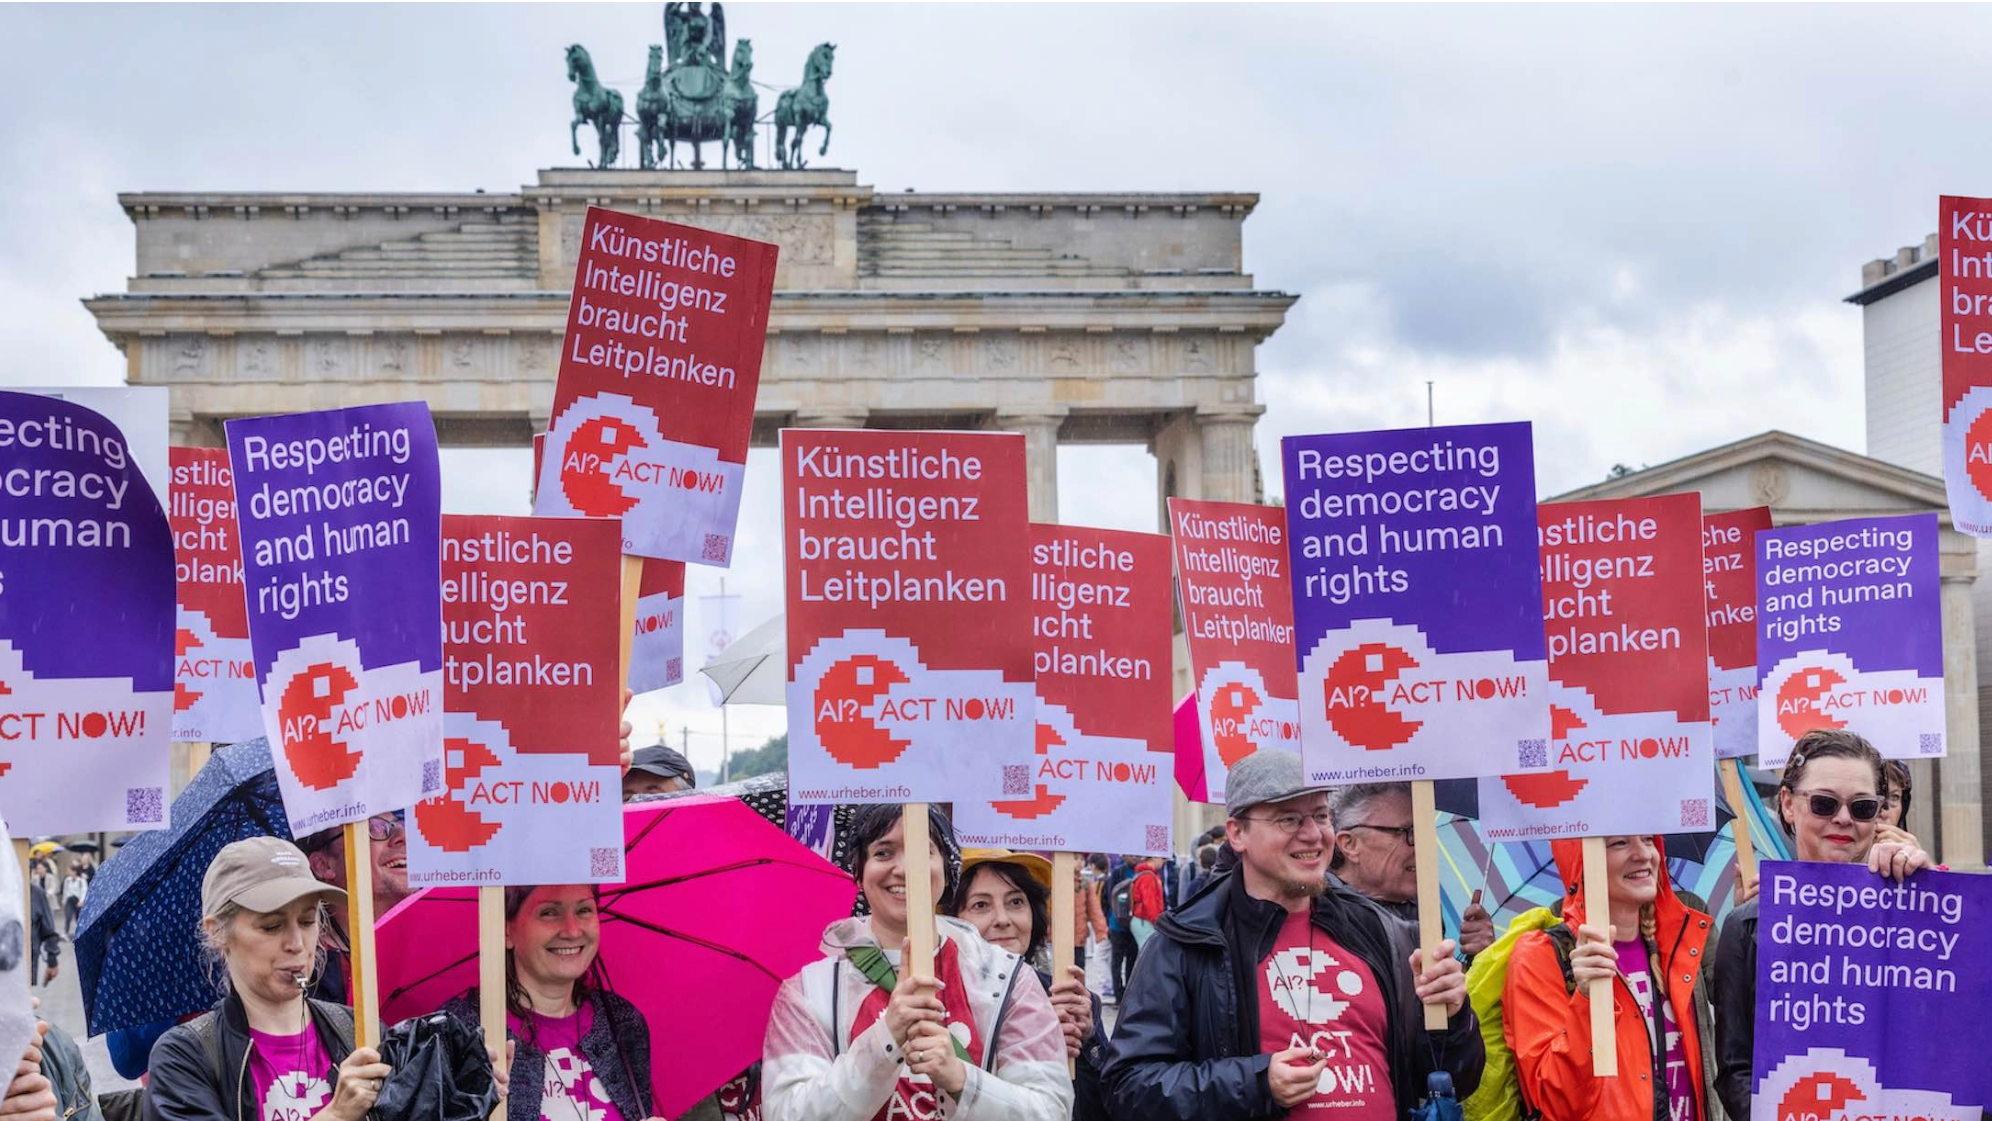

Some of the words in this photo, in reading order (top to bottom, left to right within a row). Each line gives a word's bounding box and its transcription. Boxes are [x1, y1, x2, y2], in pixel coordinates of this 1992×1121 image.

[590, 221, 736, 279] Künstliche
[584, 259, 728, 314] Intelligenz
[577, 296, 689, 344] braucht
[571, 333, 736, 390] Leitplanken
[244, 425, 411, 472] Respecting
[796, 445, 983, 481] Künstliche
[1298, 441, 1500, 484] Respecting
[0, 468, 128, 510] cracy
[564, 450, 600, 476] AI?
[614, 460, 666, 486] ACT
[669, 465, 725, 495] NOW!
[250, 472, 411, 521] democracy
[797, 487, 981, 528] Intelligenz
[1299, 484, 1501, 520] democracy
[255, 532, 315, 568] and
[324, 516, 411, 556] human
[798, 527, 938, 562] braucht
[1178, 511, 1282, 546] Künstliche
[1301, 525, 1369, 559] and
[1379, 522, 1504, 555] human
[1765, 526, 1914, 562] Respecting
[1183, 544, 1281, 581] Intelligenz
[1540, 553, 1655, 588] lligenz
[1765, 554, 1913, 587] democracy
[259, 569, 350, 621] rights
[801, 569, 1007, 610] Leitplanken
[1187, 577, 1265, 608] braucht
[1304, 564, 1410, 605] rights
[1766, 585, 1814, 614] and
[1821, 579, 1914, 608] human
[1766, 613, 1843, 642] rights
[177, 659, 223, 678] ACT
[817, 699, 859, 723] AI?
[879, 698, 937, 722] ACT
[946, 697, 1015, 721] NOW!
[1328, 685, 1370, 710] AI?
[1391, 680, 1447, 705] ACT
[1456, 675, 1527, 702] NOW!
[1779, 697, 1809, 716] AI?
[1825, 691, 1867, 710] ACT
[1873, 687, 1928, 706] NOW!
[57, 710, 145, 740] NOW!
[284, 713, 317, 746] AI?
[337, 701, 370, 735] ACT
[375, 689, 431, 724] NOW!
[1213, 718, 1236, 737] AI?
[1250, 719, 1274, 738] ACT
[1558, 740, 1612, 764] ACT
[1620, 736, 1689, 761] NOW!
[1038, 759, 1089, 781] ACT
[1097, 760, 1157, 785] NOW!
[1311, 763, 1426, 782] www.urheber.info
[470, 781, 525, 805] ACT
[532, 781, 600, 804] NOW!
[798, 785, 912, 800] www.urheber.info
[959, 833, 1066, 846] www.urheber.info
[1487, 820, 1589, 838] www.urheber.info
[1773, 874, 1963, 925] Respecting
[1771, 915, 1960, 961] democracy
[1273, 975, 1304, 991] AI?
[1770, 955, 1831, 985] and
[1842, 956, 1957, 993] human
[1769, 993, 1867, 1031] rights
[1289, 1030, 1353, 1059] ACT
[1307, 1099, 1366, 1109] www.urheber.info
